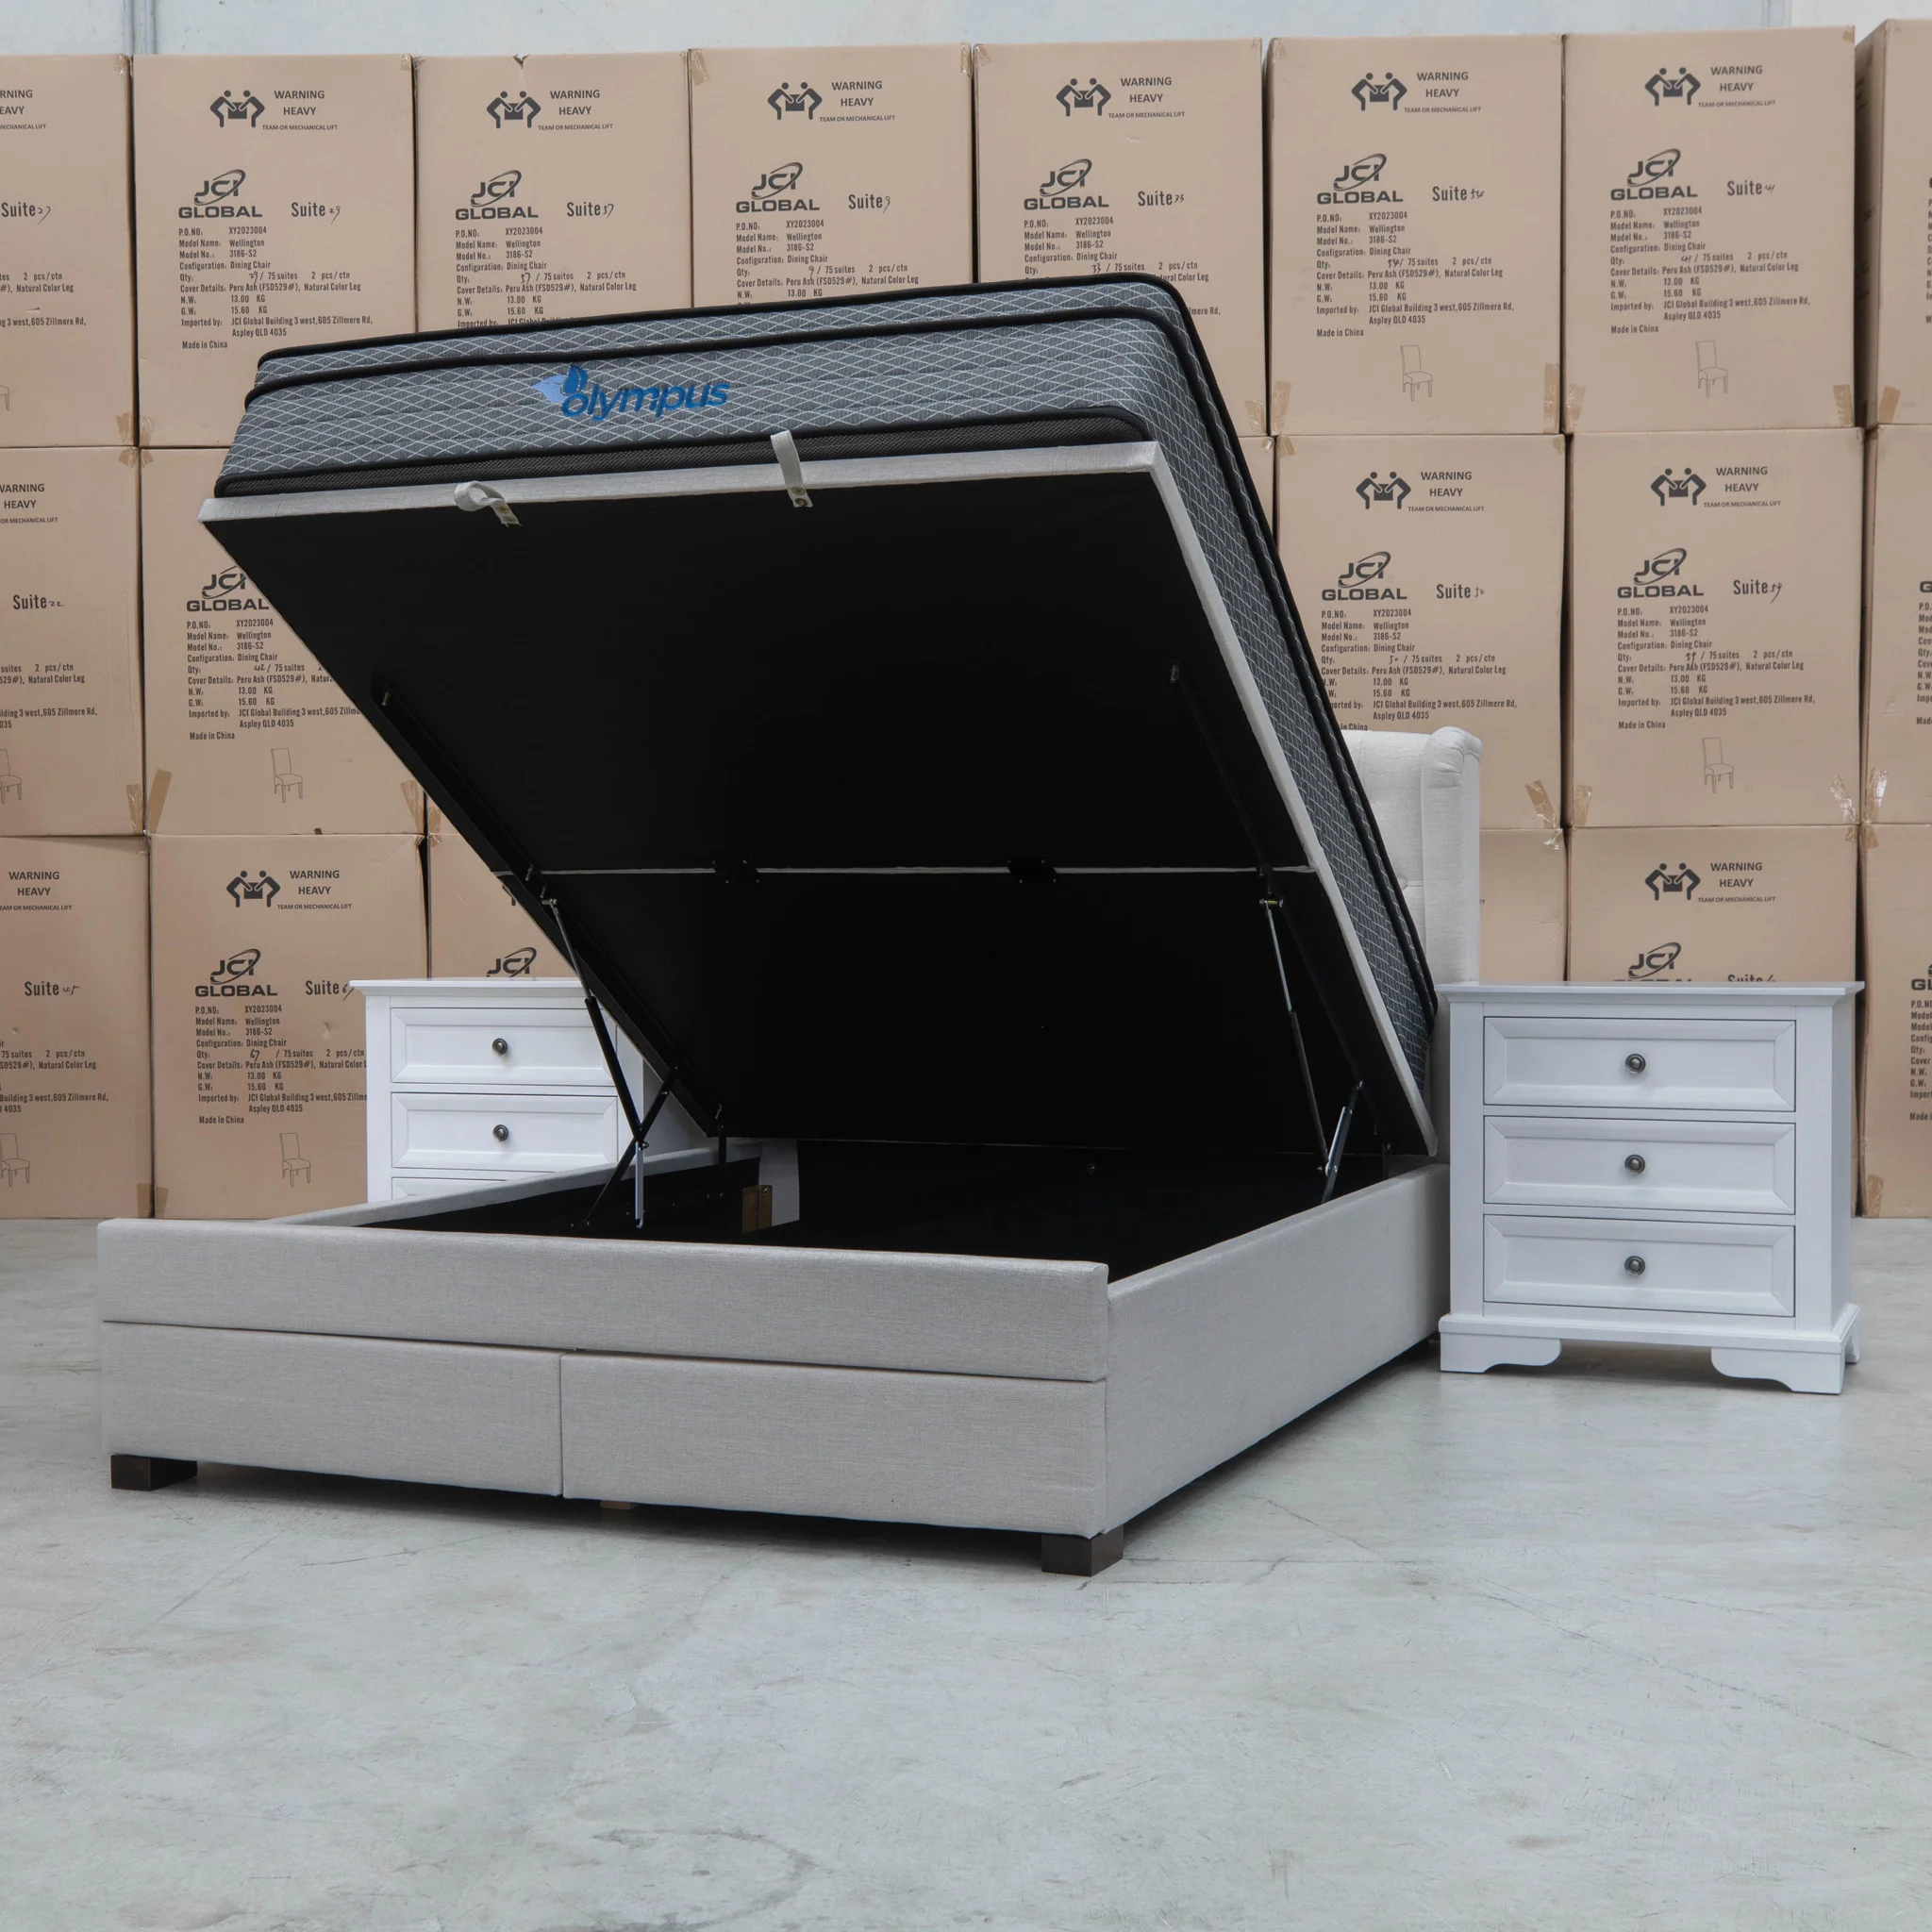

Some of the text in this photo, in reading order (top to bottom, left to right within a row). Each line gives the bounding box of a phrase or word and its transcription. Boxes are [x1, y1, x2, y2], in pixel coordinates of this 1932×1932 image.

[1710, 65, 1764, 76] WARNING
[1121, 76, 1172, 87] WARNING
[1417, 72, 1469, 82] WARNING
[831, 80, 883, 91] WARNING
[1720, 82, 1755, 92] HEAVY
[0, 90, 33, 98] RNING
[274, 90, 325, 99] WARNING
[550, 90, 600, 100] WARNING
[1130, 93, 1163, 103] HEAVY
[1426, 88, 1459, 98] HEAVY
[841, 97, 874, 107] HEAVY
[0, 106, 25, 115] EAVY
[283, 107, 316, 115] HEAVY
[558, 106, 591, 115] HEAVY
[1610, 185, 1697, 201] GLOBAL
[1727, 180, 1763, 196] Suite
[1138, 191, 1174, 207] Suite
[1317, 191, 1403, 205] GLOBAL
[1432, 186, 1468, 202] Suite
[736, 198, 820, 213] GLOBAL
[848, 193, 883, 209] Suite
[1024, 195, 1108, 210] GLOBAL
[1, 202, 37, 217] Suite
[178, 206, 262, 219] GLOBAL
[291, 202, 325, 217] Suite
[455, 206, 539, 221] GLOBAL
[567, 202, 601, 217] Suite
[228, 226, 267, 235] XY2023004
[179, 239, 198, 247] Model
[229, 238, 265, 248] Wellington
[179, 250, 199, 258] Model
[229, 249, 257, 258] 3186-S2
[230, 260, 252, 270] Dining
[253, 260, 271, 269] Chair
[1318, 306, 1348, 316] Imported
[1369, 304, 1379, 314] JCI
[1381, 304, 1403, 313] Global
[1404, 303, 1432, 315] Building
[1434, 303, 1438, 311] 3
[1473, 302, 1502, 311] Zillmere
[1370, 315, 1425, 326] Aspley QLD 4035
[1421, 472, 1473, 481] WARNING
[1716, 466, 1769, 476] WARNING
[1430, 488, 1463, 497] HEAVY
[1725, 483, 1759, 492] HEAVY
[1436, 584, 1472, 599] Suite
[1617, 584, 1704, 598] GLOBAL
[1733, 579, 1769, 595] Suite
[1322, 588, 1407, 601] GLOBAL
[13, 594, 48, 610] Suite
[186, 598, 270, 612] GLOBAL
[1670, 675, 1689, 683] 13.00
[1670, 686, 1690, 694] 15.60
[1698, 686, 1707, 694] KG
[1620, 721, 1667, 730] Made in China
[1710, 861, 1762, 872] WARNING
[8, 871, 59, 880] WARNING
[289, 870, 340, 879] WARNING
[1720, 878, 1753, 888] HEAVY
[17, 887, 50, 896] HEAVY
[298, 886, 331, 895] HEAVY
[25, 981, 60, 996] Suite
[194, 984, 277, 997] GLOBAL
[306, 981, 341, 995] Suite
[292, 1049, 313, 1058] suites
[326, 1048, 331, 1057] 2
[197, 1061, 216, 1070] Cover
[245, 1060, 260, 1070] Peru
[261, 1060, 274, 1069] Ash
[319, 1059, 343, 1069] Natural
[345, 1059, 363, 1068] Color
